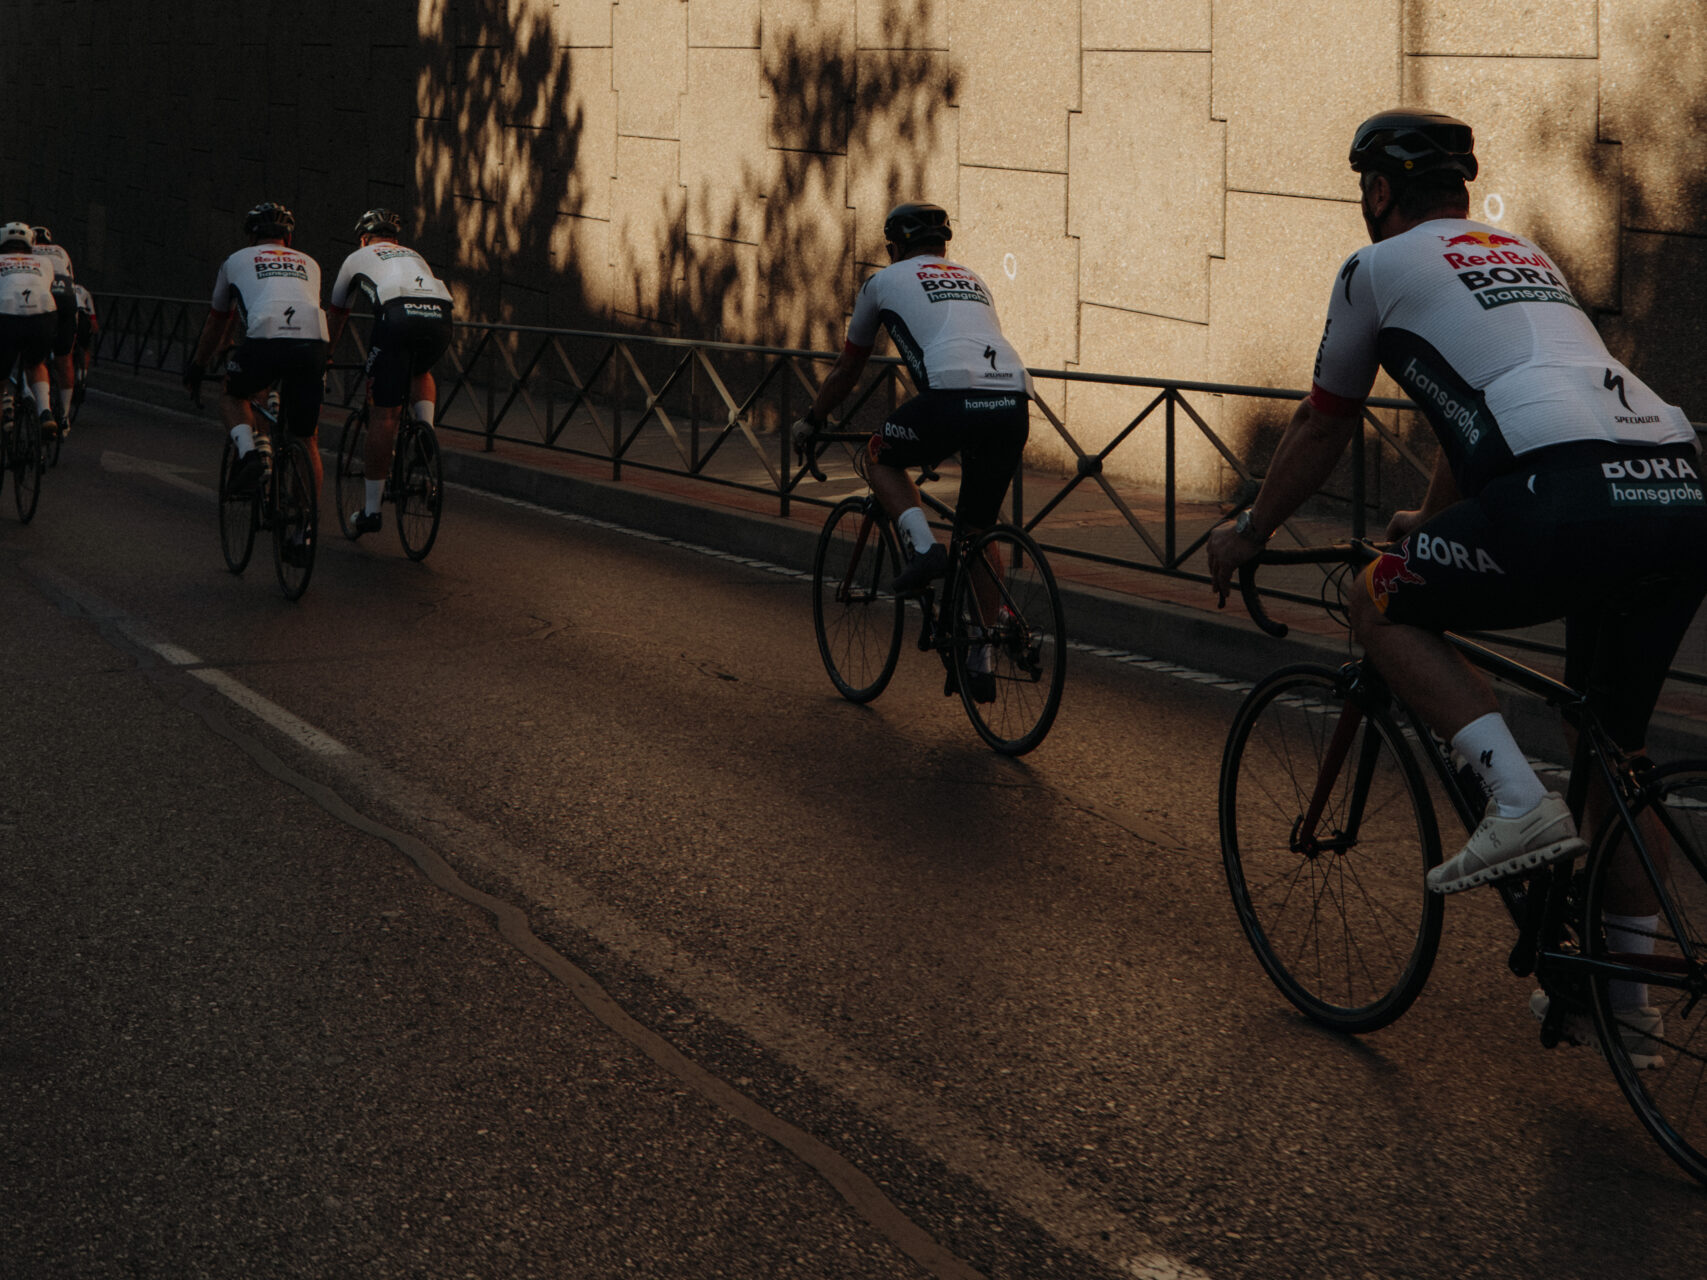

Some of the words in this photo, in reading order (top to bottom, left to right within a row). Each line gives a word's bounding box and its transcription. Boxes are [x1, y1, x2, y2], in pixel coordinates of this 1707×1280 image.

[255, 262, 306, 273] BORA
[1443, 250, 1506, 269] Red
[1500, 251, 1552, 270] Bull
[916, 271, 952, 280] Red
[1458, 267, 1568, 291] BORA
[921, 279, 985, 294] BORA
[965, 395, 1017, 410] hansgrohe
[1403, 357, 1480, 445] hansgrohe
[885, 421, 920, 441] BORA
[1601, 457, 1698, 480] BORA
[1611, 482, 1703, 505] hansgrohe
[1416, 531, 1507, 575] BORA
